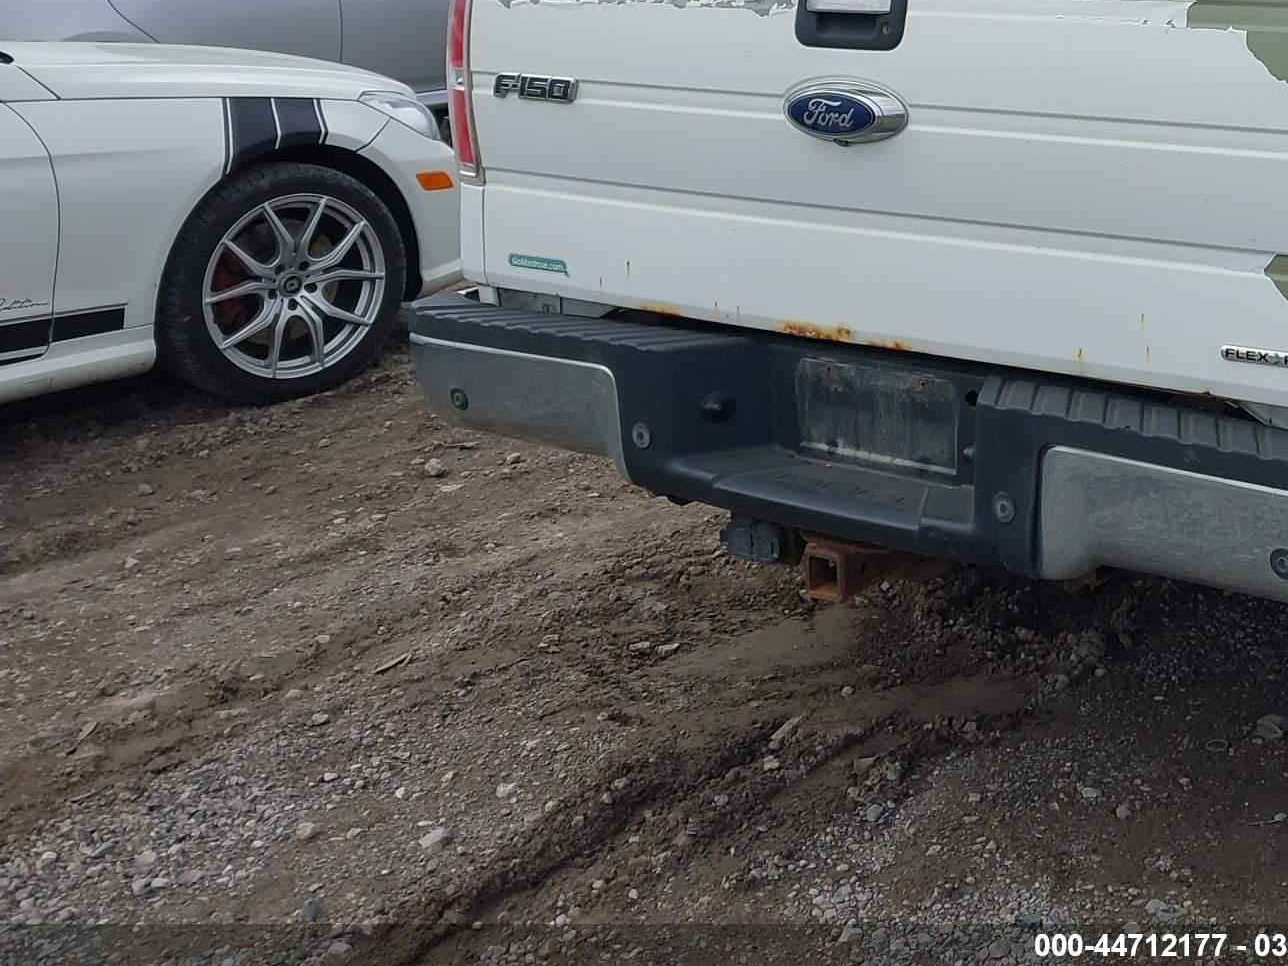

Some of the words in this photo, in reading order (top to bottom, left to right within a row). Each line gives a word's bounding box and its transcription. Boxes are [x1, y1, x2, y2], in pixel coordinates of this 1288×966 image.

[493, 72, 579, 104] F-150
[803, 97, 854, 131] Ford
[511, 256, 565, 272] GoMontrose.com
[1224, 347, 1269, 363] FLEX
